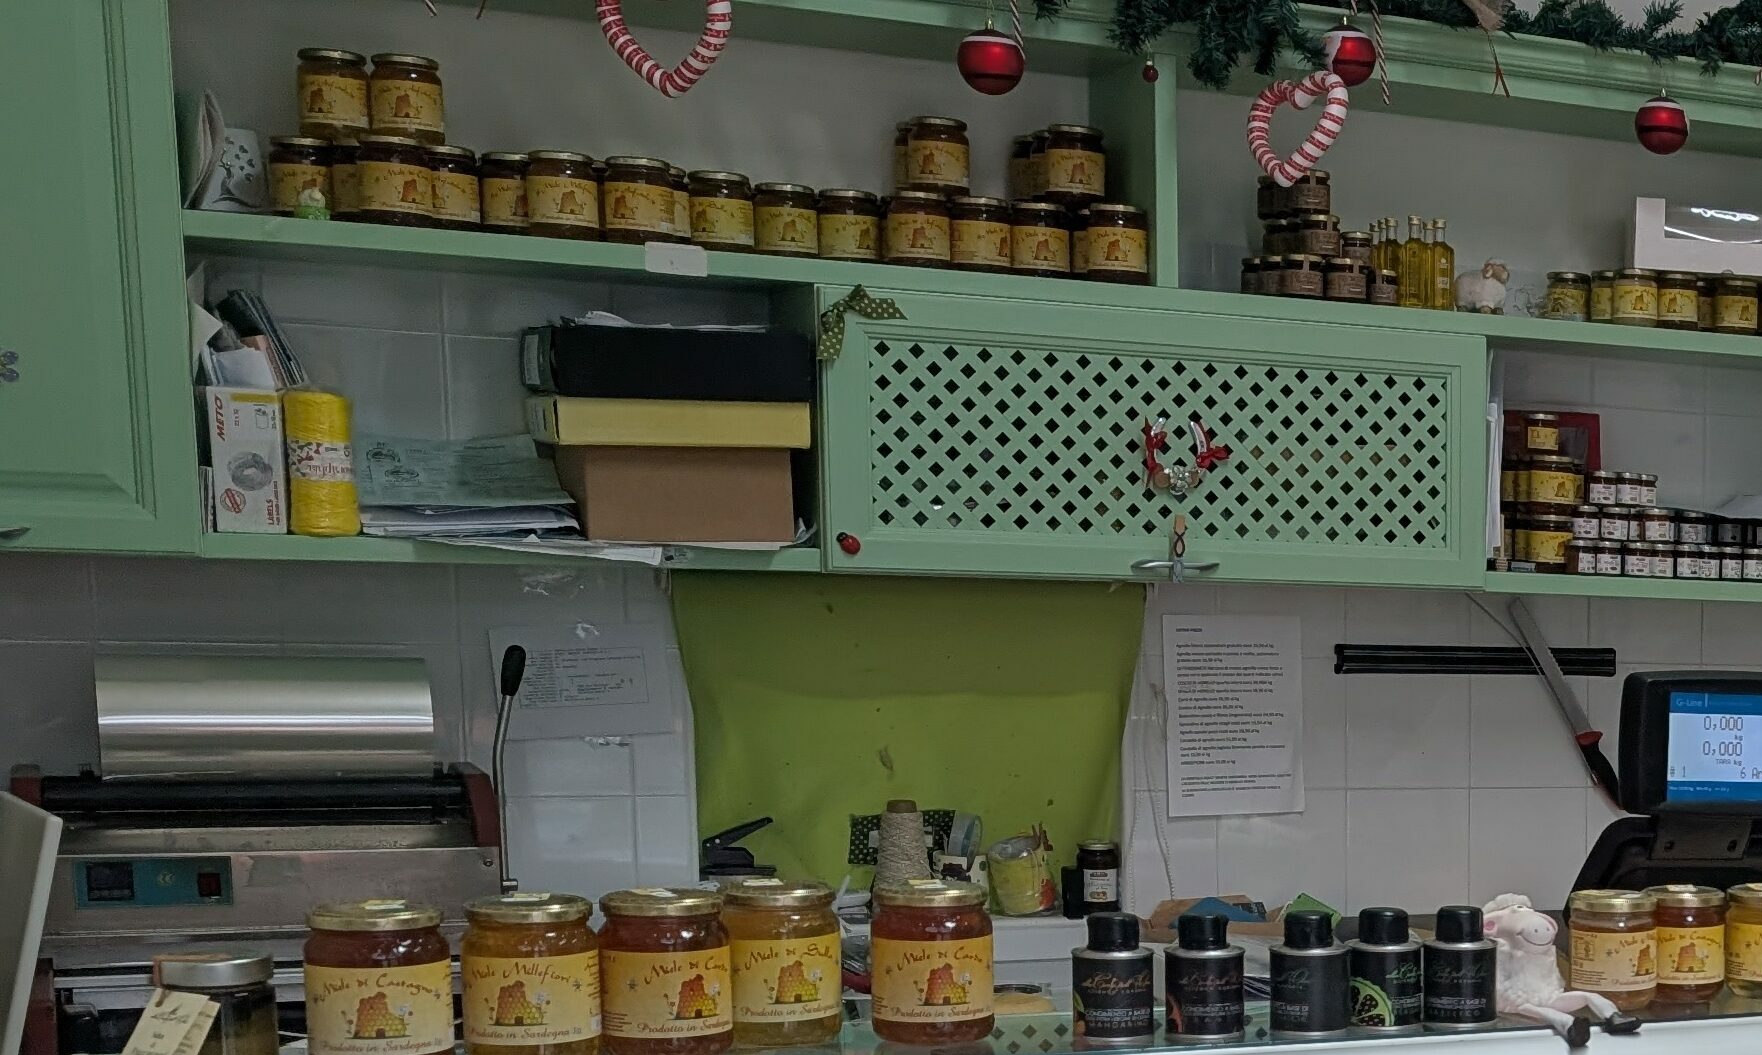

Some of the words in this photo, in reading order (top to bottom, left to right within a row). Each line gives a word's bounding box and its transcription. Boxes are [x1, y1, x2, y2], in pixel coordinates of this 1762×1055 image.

[215, 394, 226, 441] METO
[1704, 716, 1743, 731] 0,000
[1703, 741, 1742, 756] 0,000
[1740, 768, 1745, 779] 6
[745, 946, 778, 970] Miele
[897, 949, 931, 971] Miele
[503, 962, 571, 984] Millefiori
[645, 960, 682, 984] Miele
[376, 973, 432, 995] Castagno
[506, 1030, 516, 1039] in
[521, 1027, 570, 1040] Sardegna
[637, 1022, 683, 1033] Prodotto
